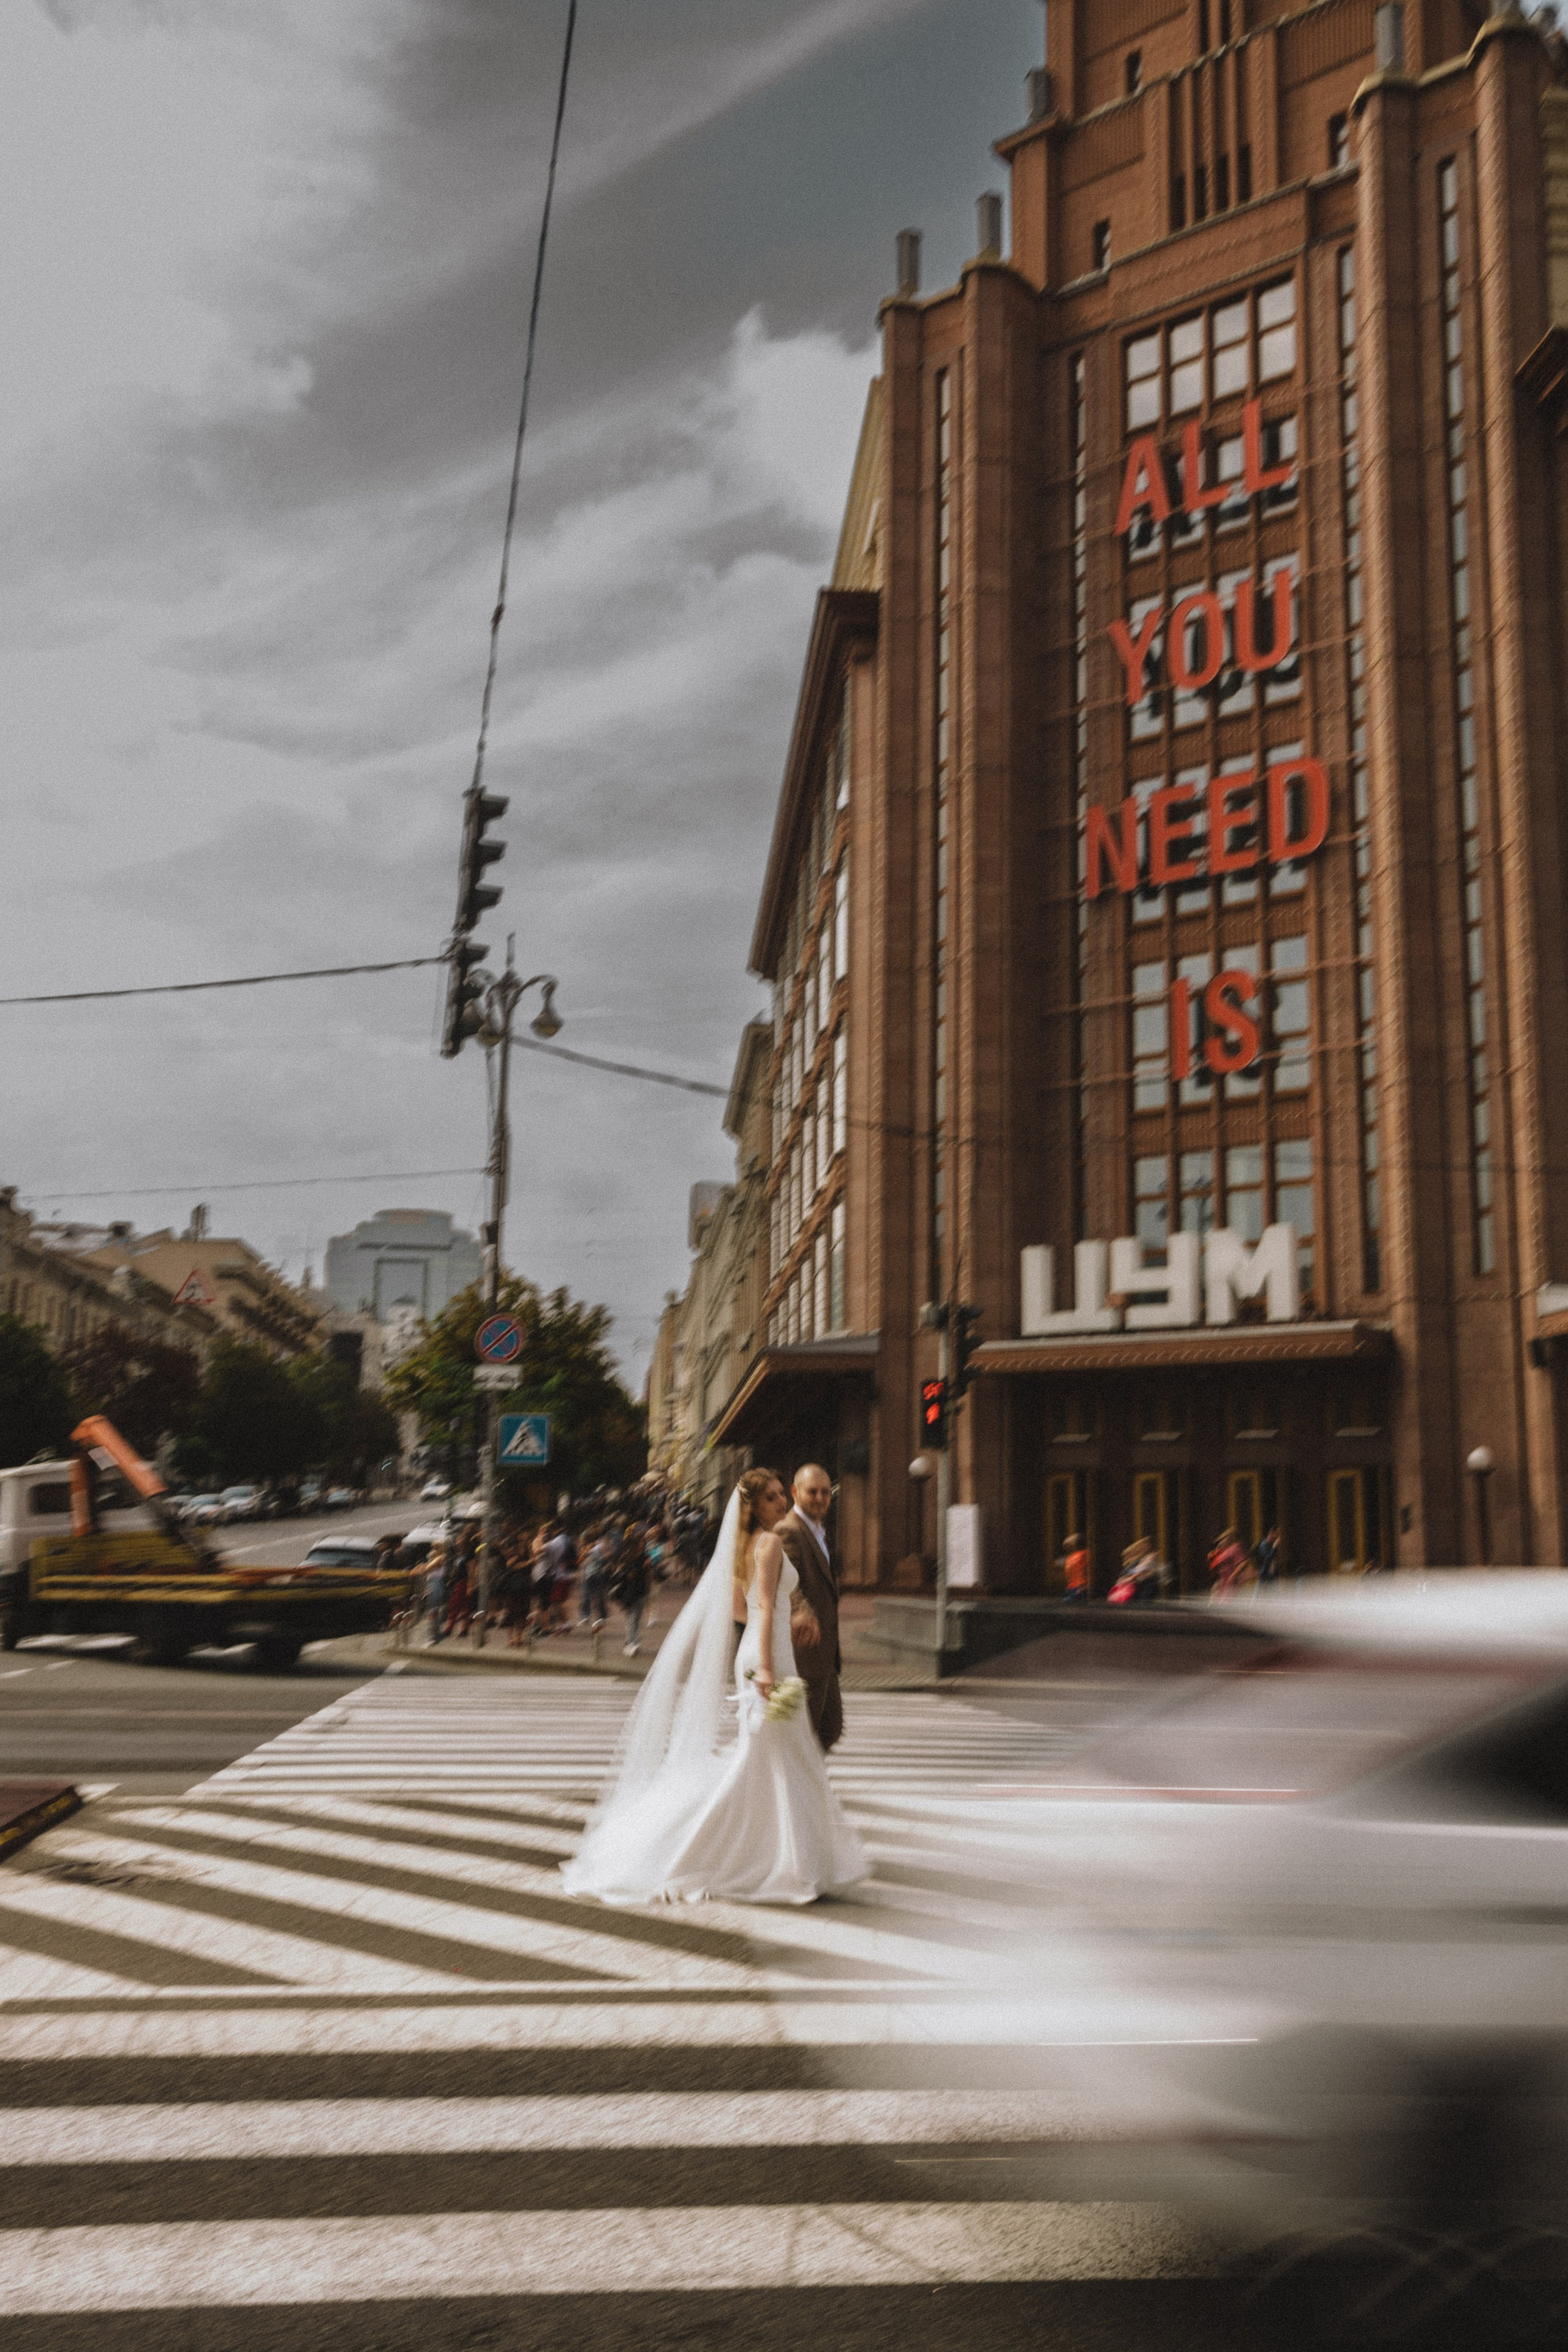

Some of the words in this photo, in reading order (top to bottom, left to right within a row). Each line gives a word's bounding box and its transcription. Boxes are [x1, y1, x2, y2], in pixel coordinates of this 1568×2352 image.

[1114, 399, 1292, 535] ALL
[1107, 568, 1292, 705] YOU
[1085, 756, 1330, 899] NEED
[1170, 970, 1260, 1080] IS
[1021, 1223, 1298, 1336] ЦУМ
